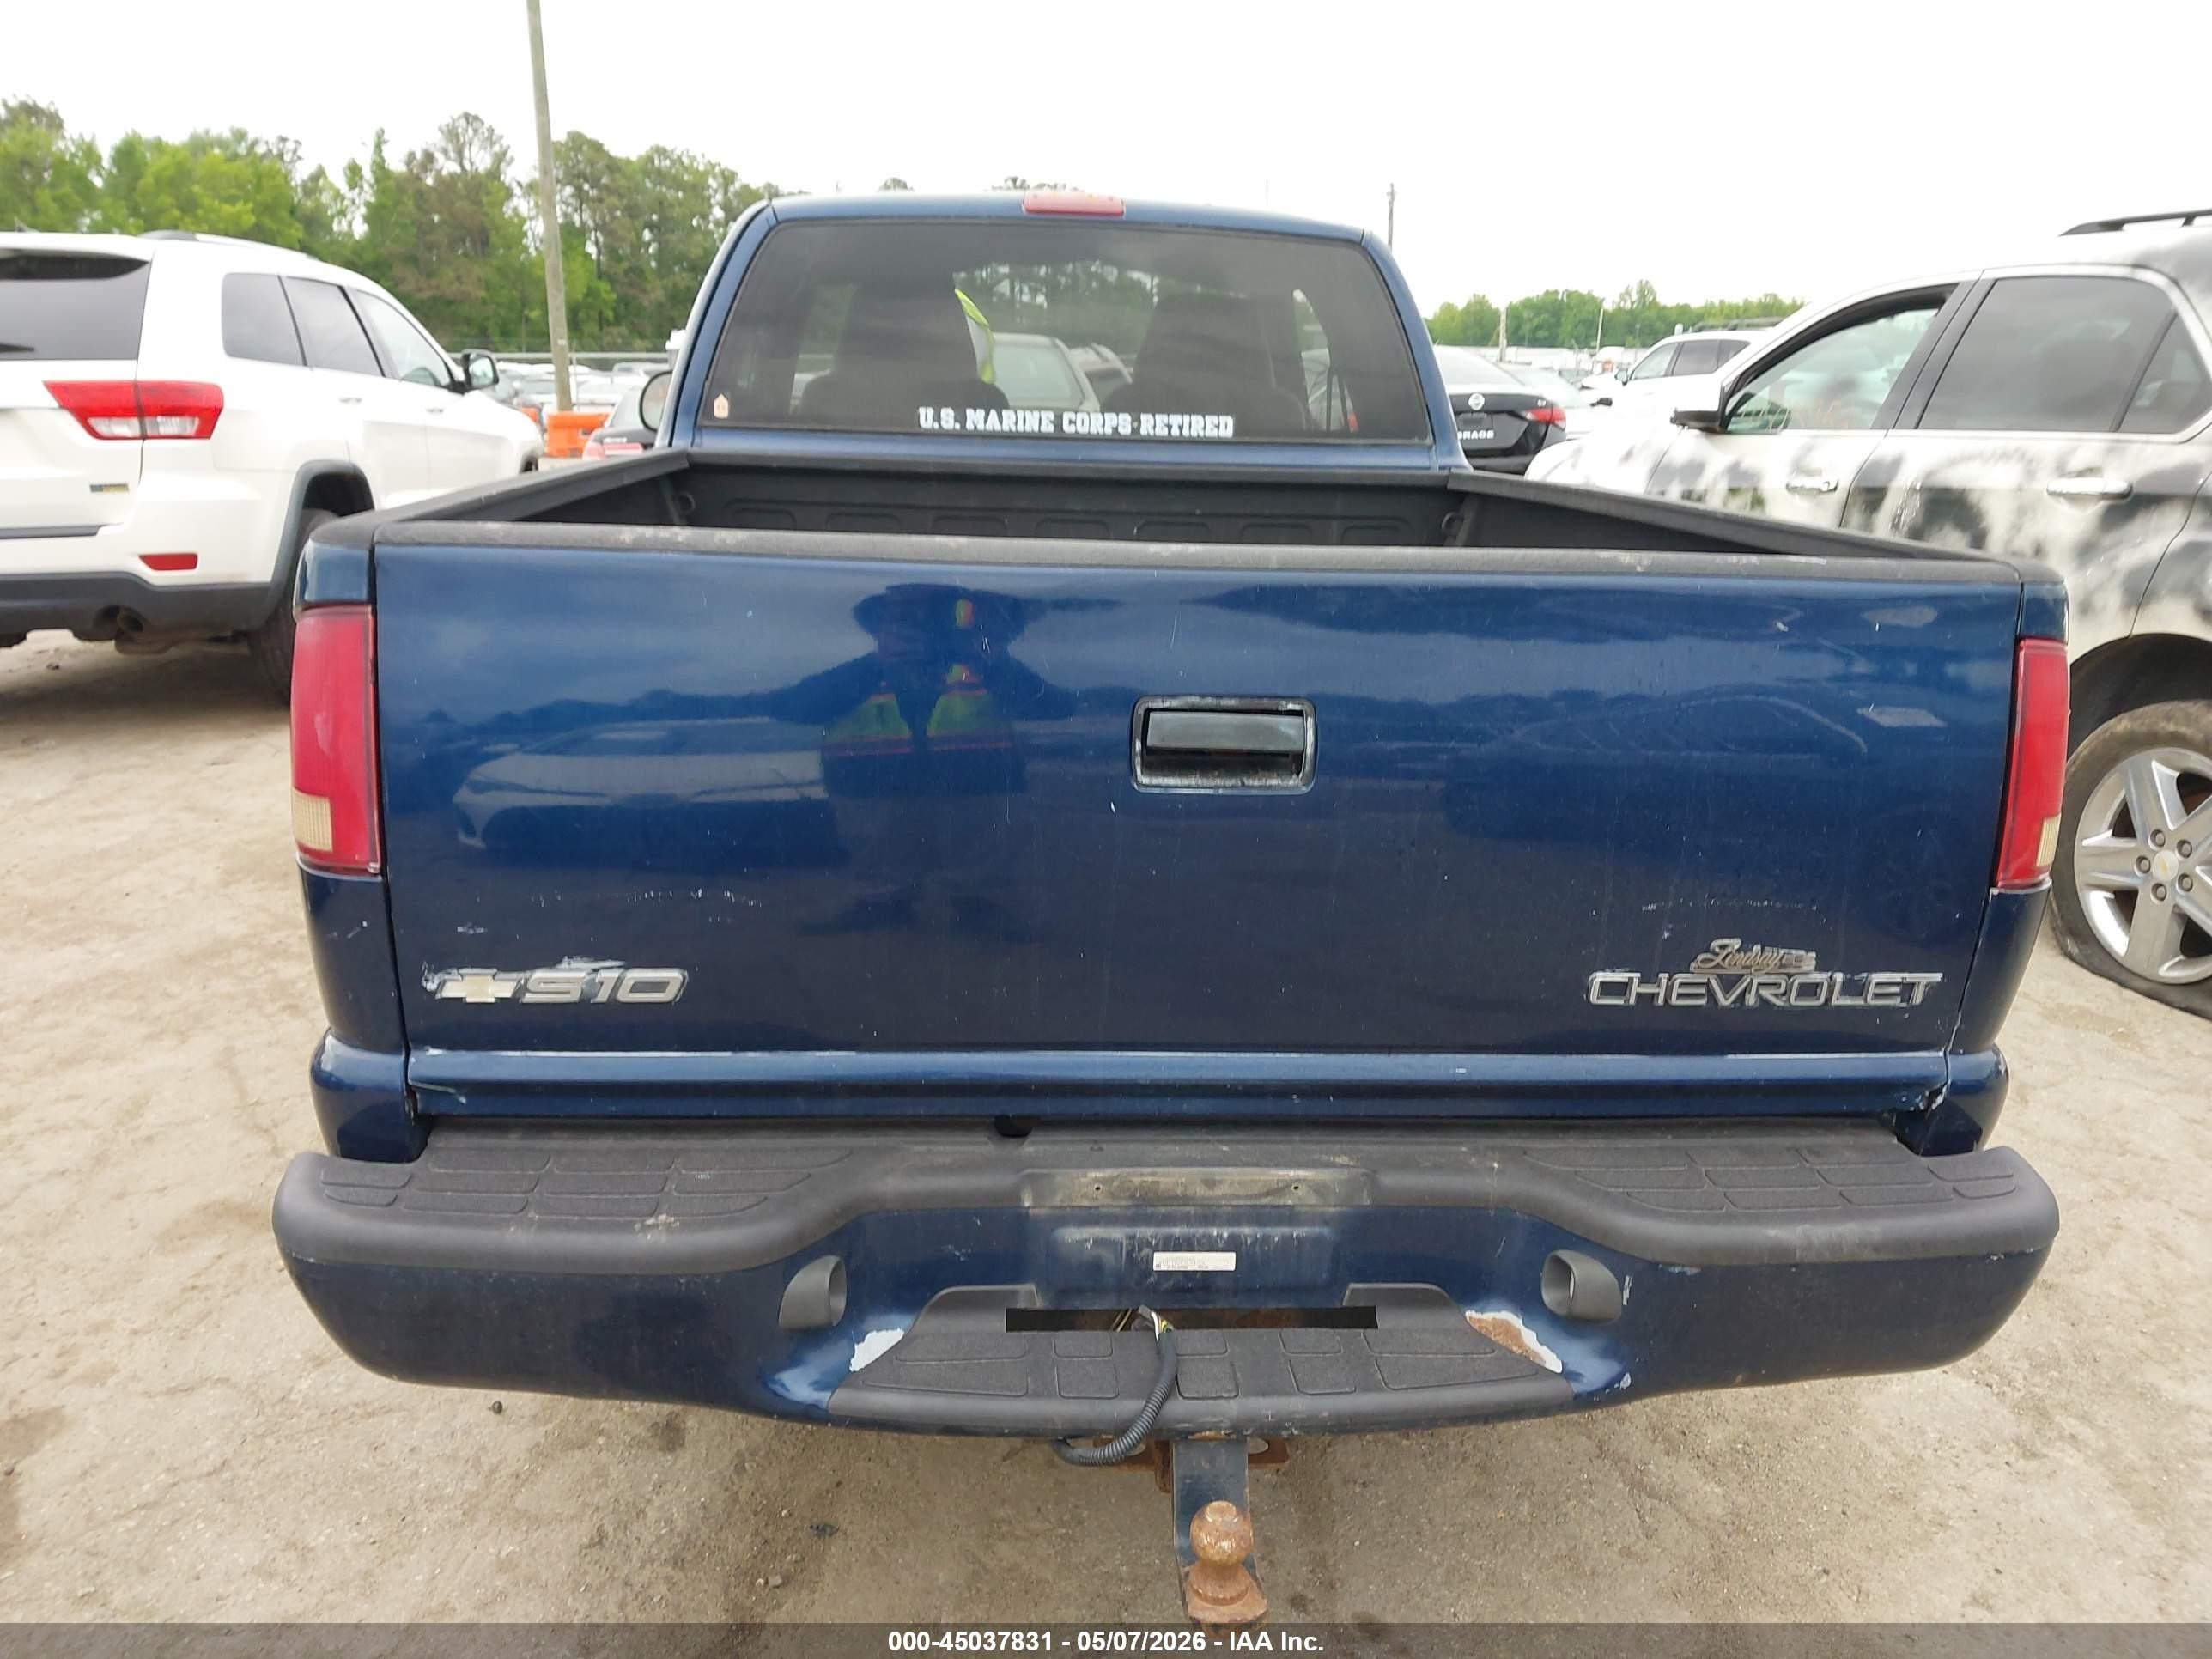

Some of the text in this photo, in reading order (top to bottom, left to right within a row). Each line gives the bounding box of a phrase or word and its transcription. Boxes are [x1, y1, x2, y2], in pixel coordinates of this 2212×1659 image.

[919, 406, 961, 430] U.S.
[965, 408, 1054, 434] MARINE
[519, 967, 689, 1004] S10
[1588, 971, 1944, 1008] CHEVROLET
